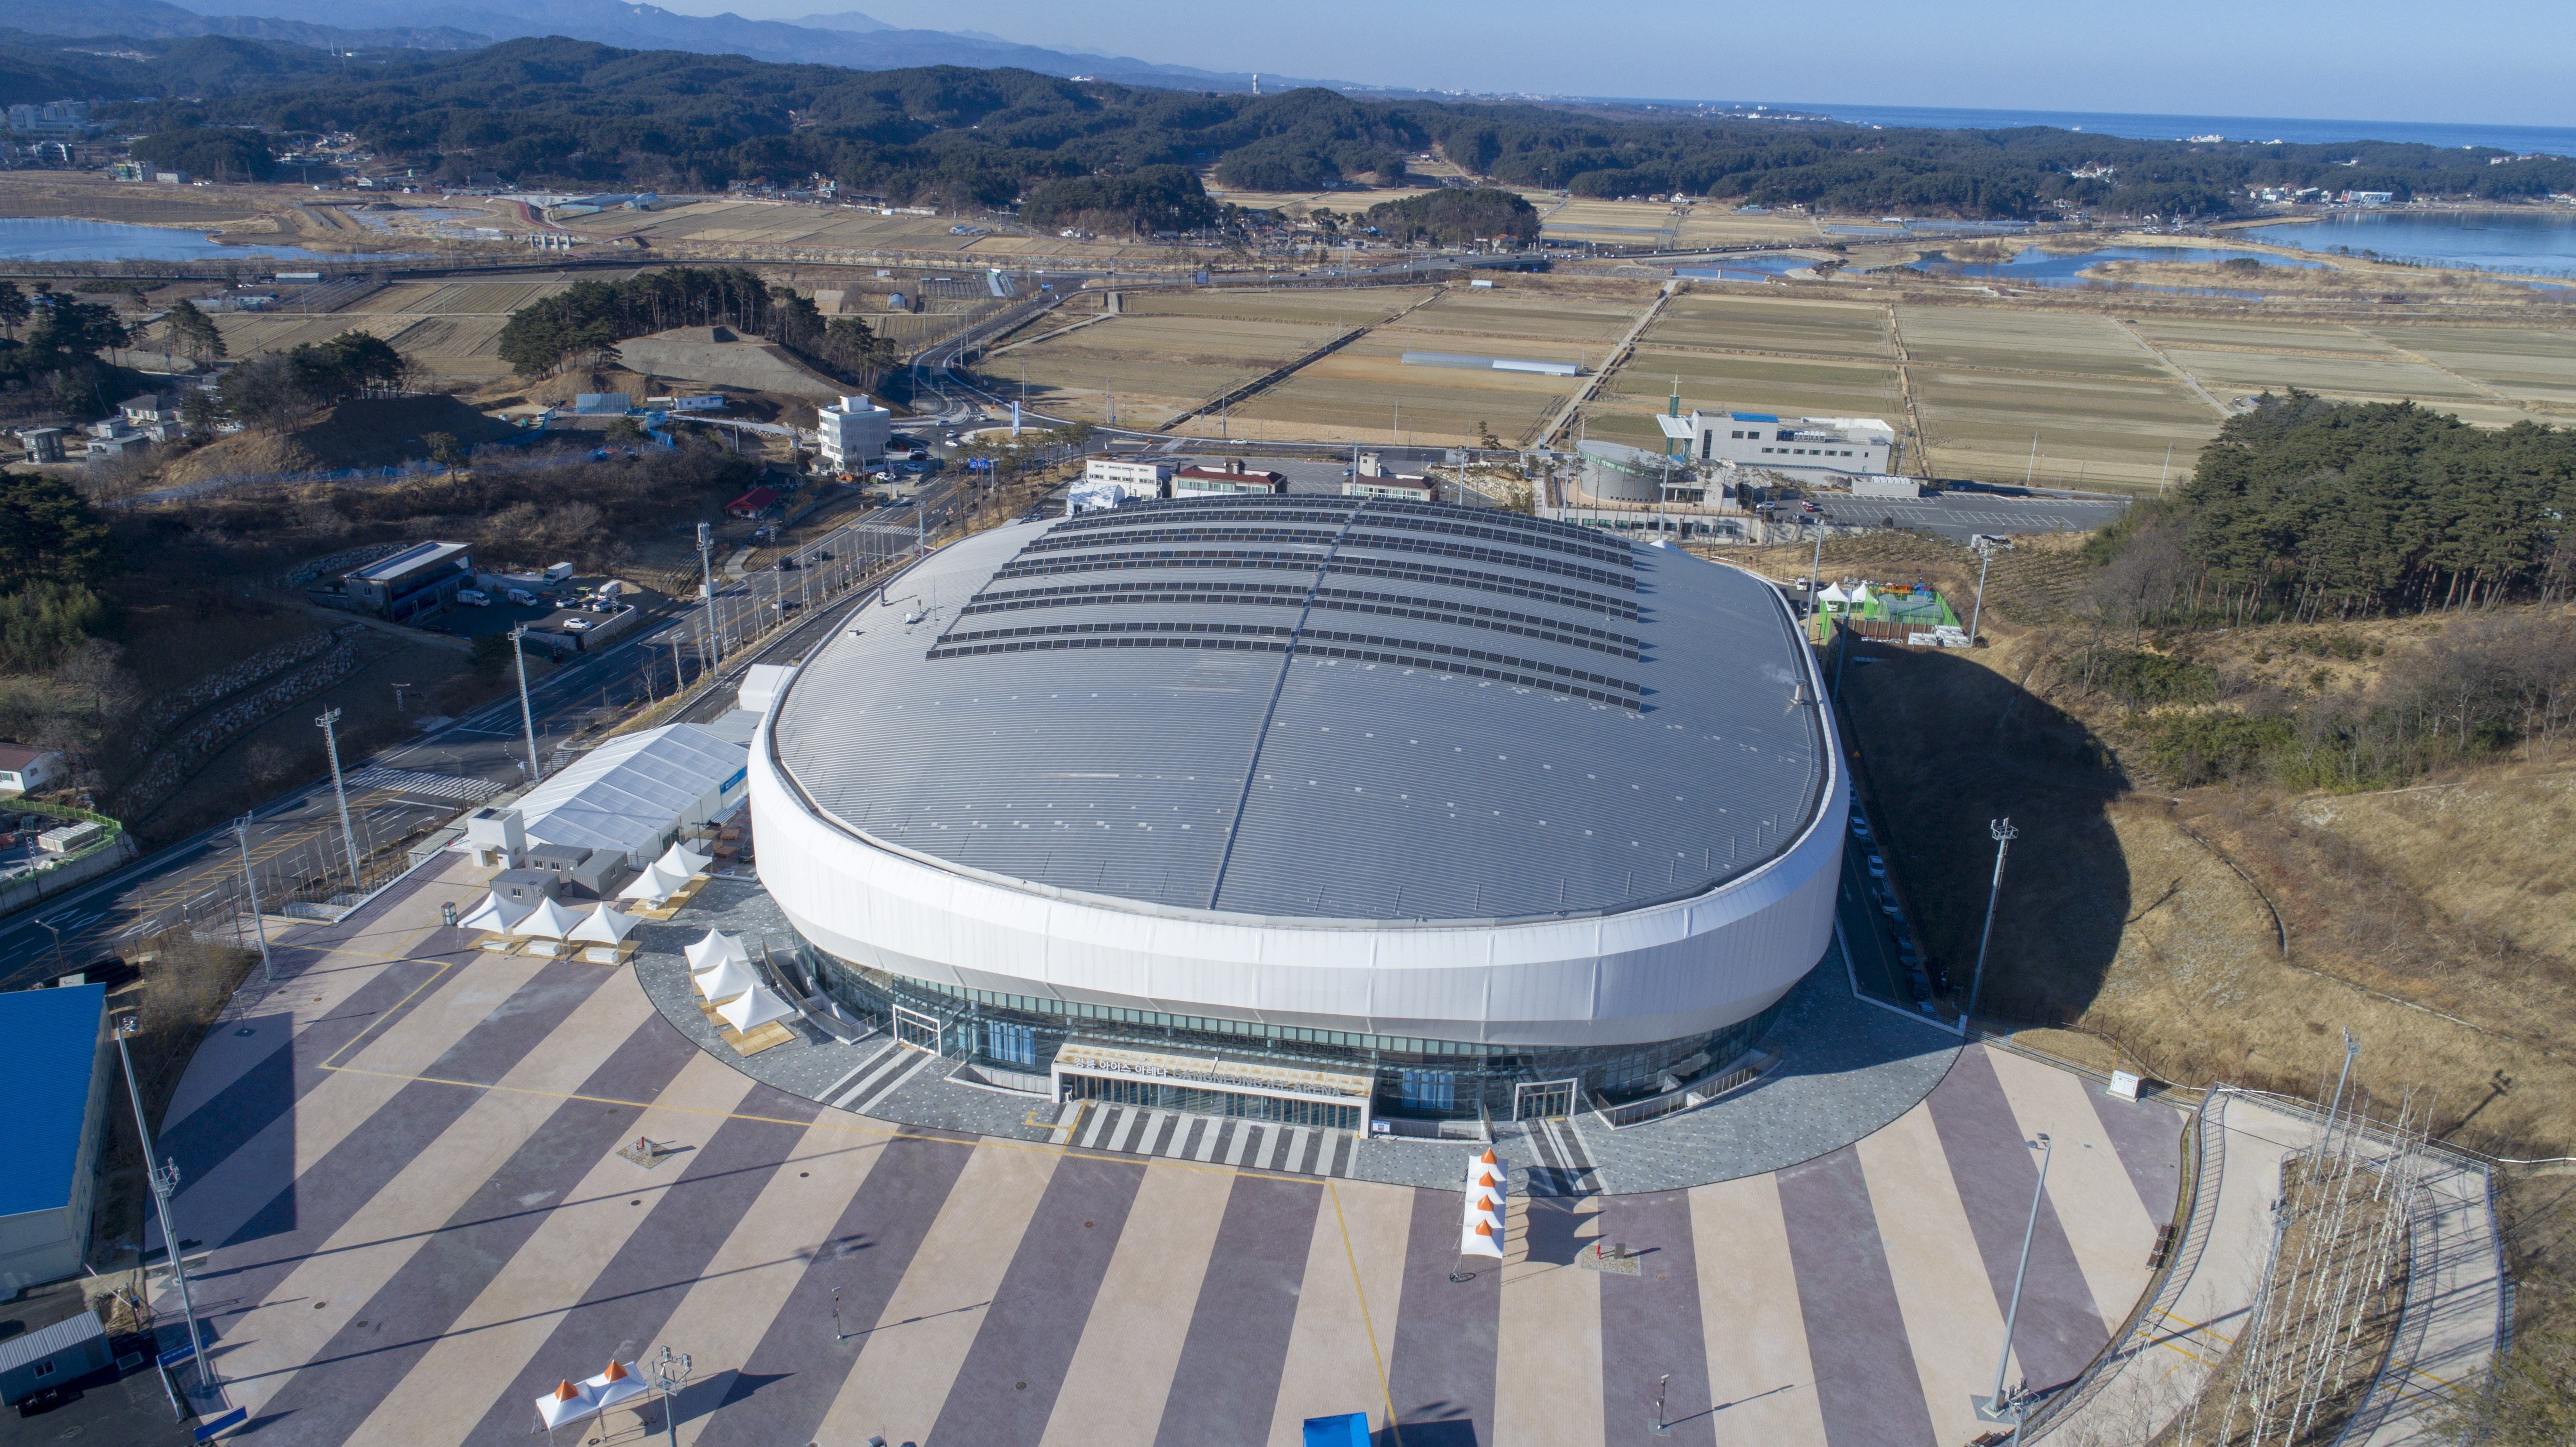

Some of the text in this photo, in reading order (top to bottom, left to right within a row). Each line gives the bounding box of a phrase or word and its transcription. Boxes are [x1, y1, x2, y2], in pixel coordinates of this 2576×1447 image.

[1074, 1057, 1168, 1077] 강릉 아이스 아레나
[1172, 1068, 1341, 1097] GANGNEUNG ICE ARENA
